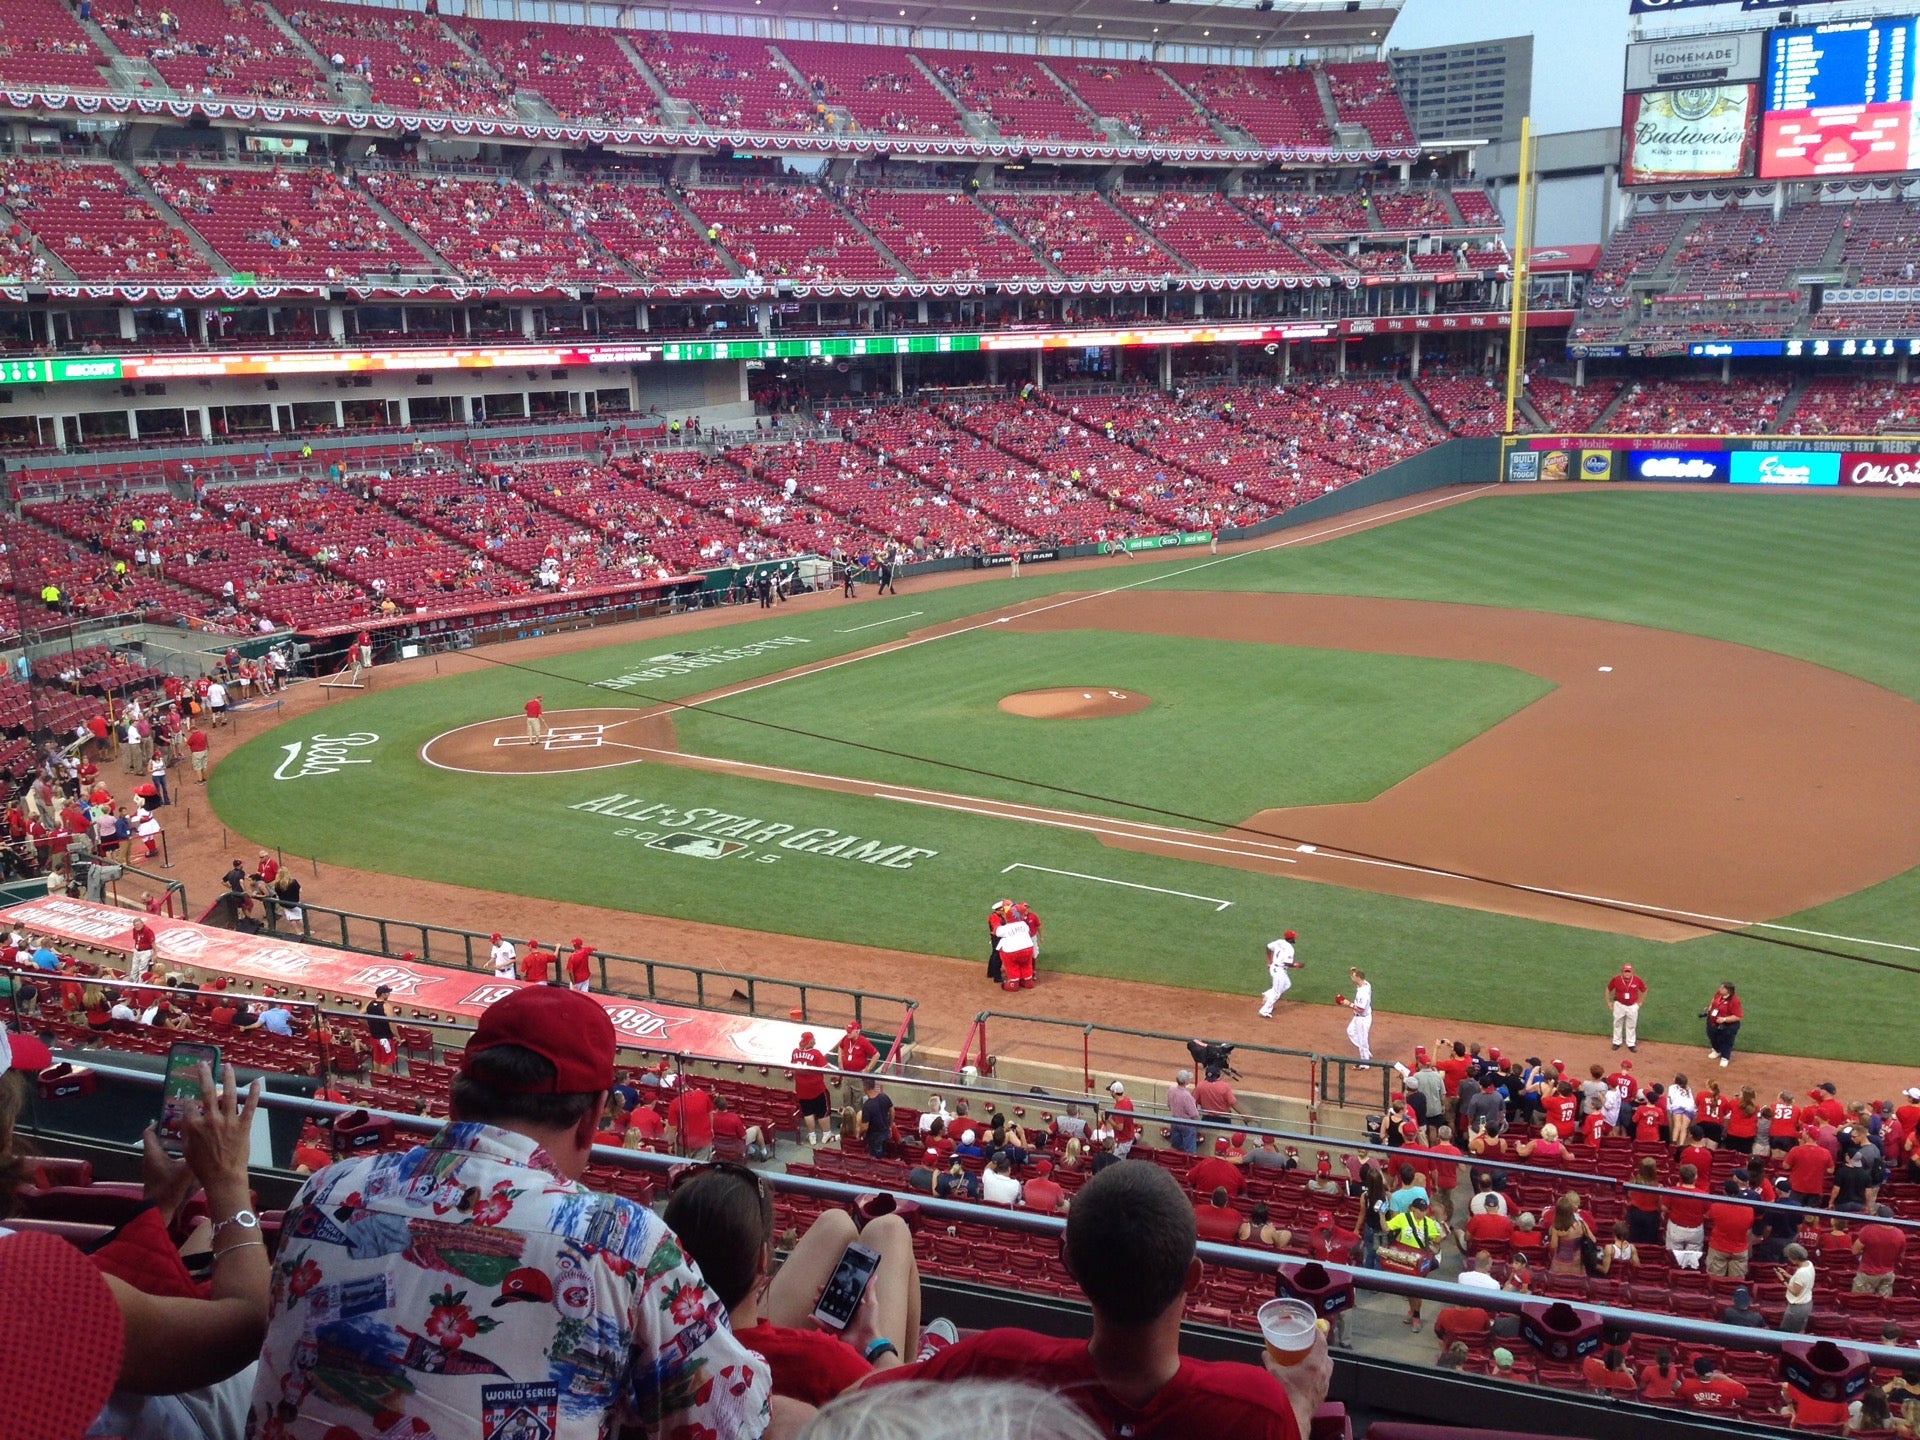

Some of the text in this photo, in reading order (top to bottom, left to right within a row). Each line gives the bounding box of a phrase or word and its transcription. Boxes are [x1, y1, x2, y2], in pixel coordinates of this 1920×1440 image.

[1654, 49, 1732, 65] HOMEMADE
[1686, 71, 1713, 79] CREAM
[1634, 121, 1745, 145] Budweiser
[1350, 322, 1375, 333] CHAMPIONS
[1752, 441, 1769, 450] FOR
[1771, 441, 1803, 451] SAFETY
[1814, 441, 1851, 452] SERVICE
[1854, 442, 1875, 452] TEXT
[1513, 455, 1535, 463] BUILT
[1852, 461, 1889, 484] Old
[1032, 552, 1054, 561] RAM
[779, 828, 939, 869] GAME
[42, 900, 97, 918] WORLD
[6, 908, 124, 939] CHAMPIONS
[358, 966, 425, 993] 1975
[470, 987, 514, 1004] 19
[793, 1051, 815, 1061] FRAZIER
[1774, 1108, 1793, 1120] 32
[485, 1387, 557, 1401] WORLD SERIES
[1692, 1392, 1722, 1403] BRUCE
